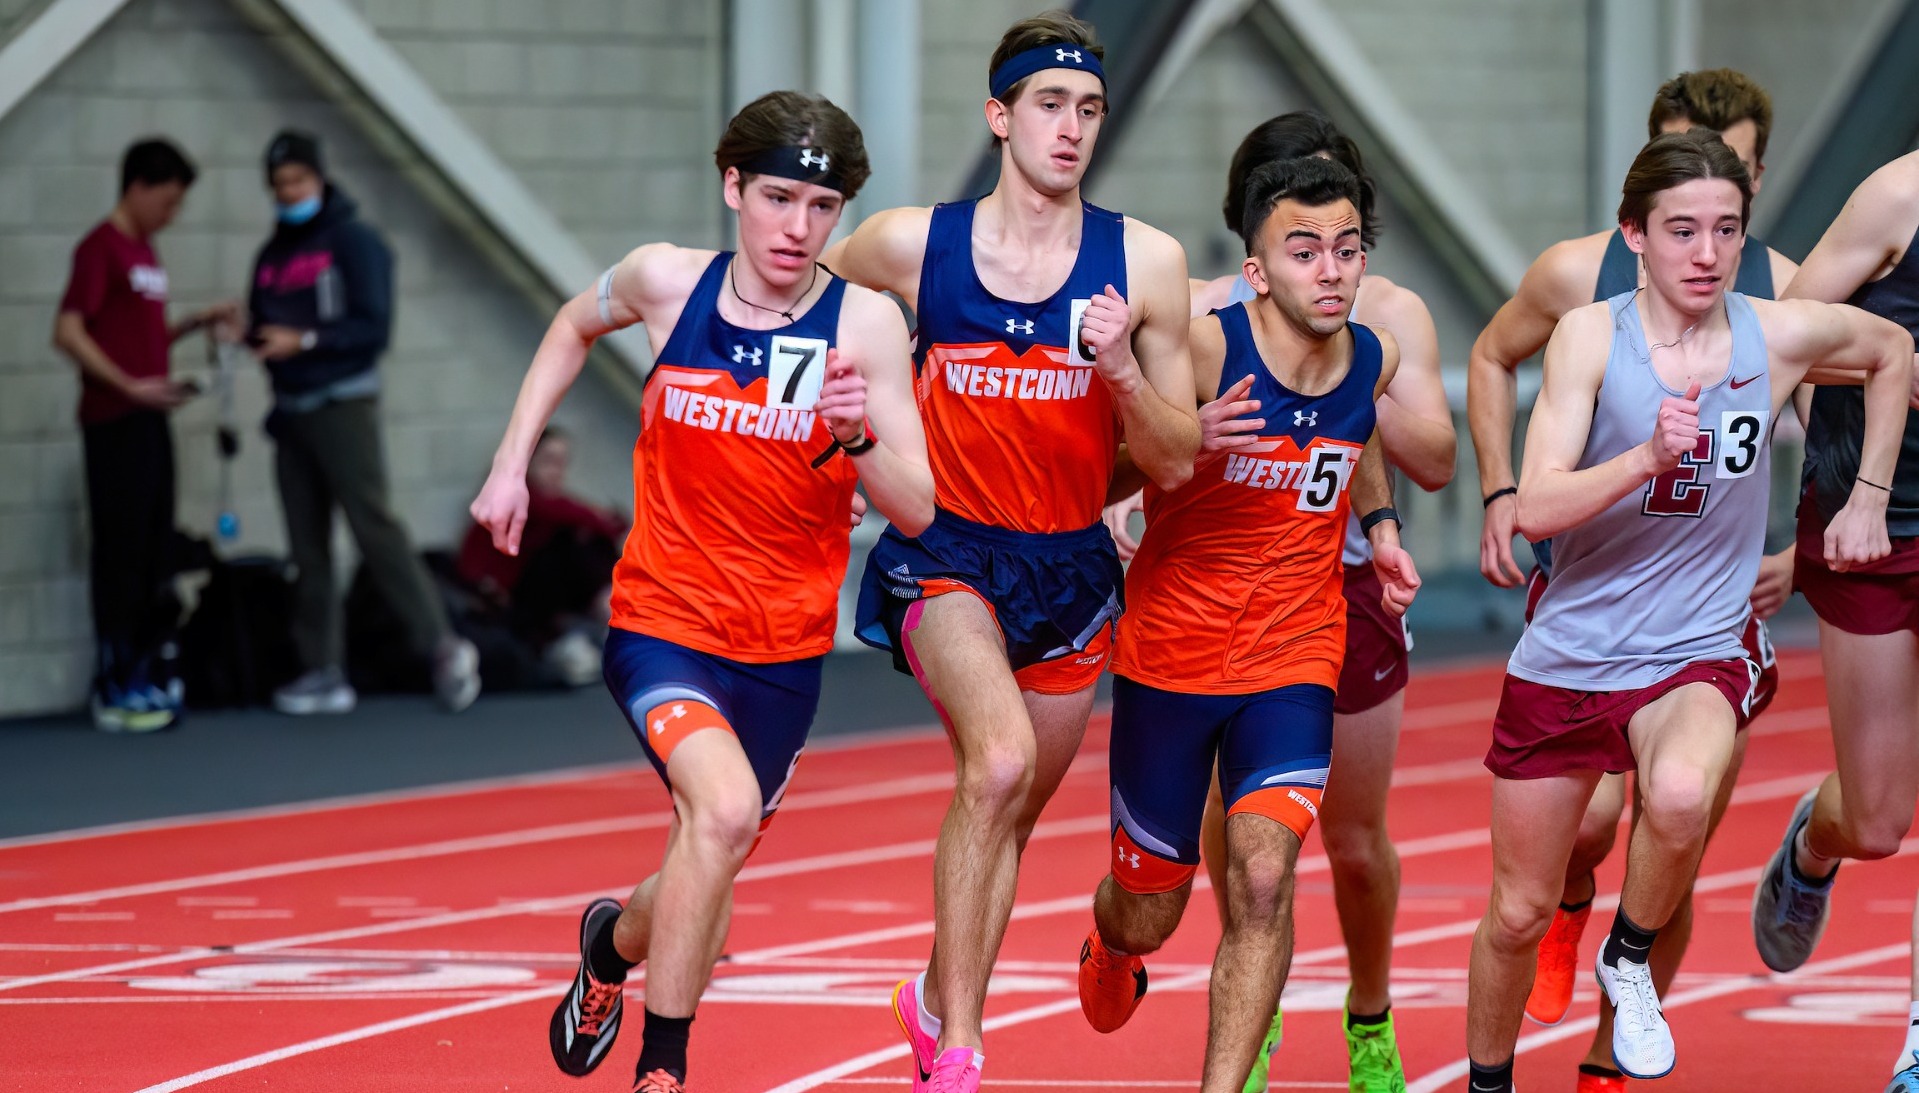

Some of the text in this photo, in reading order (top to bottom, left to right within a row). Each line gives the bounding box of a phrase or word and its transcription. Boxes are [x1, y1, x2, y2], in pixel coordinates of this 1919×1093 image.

[779, 344, 817, 404] 7
[945, 361, 1093, 401] WESTCONN
[664, 385, 817, 443] WESTCONN
[1641, 428, 1715, 519] E
[1725, 415, 1760, 474] 3
[1306, 453, 1343, 507] 5
